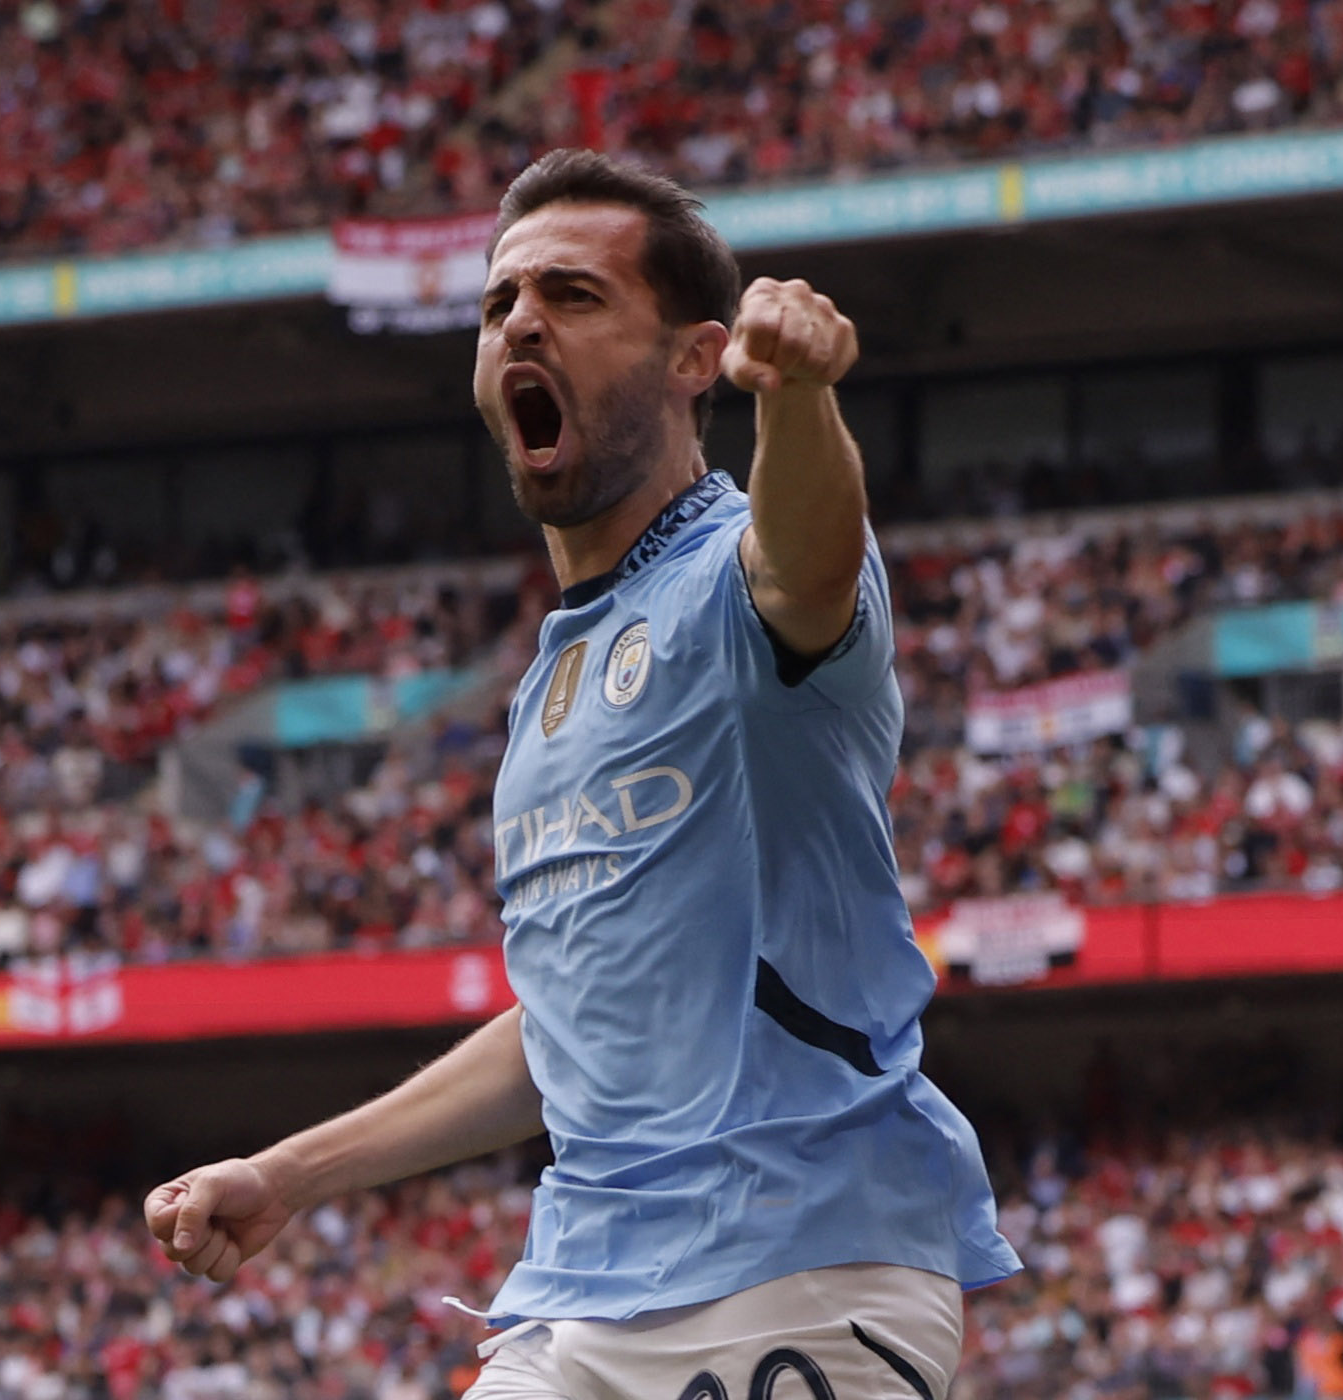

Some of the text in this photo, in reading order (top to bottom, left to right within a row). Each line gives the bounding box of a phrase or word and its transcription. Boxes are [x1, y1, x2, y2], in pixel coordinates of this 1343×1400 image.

[612, 625, 649, 660] MANCHE
[494, 766, 693, 881] TIHAD
[510, 853, 623, 911] AIRWAYS
